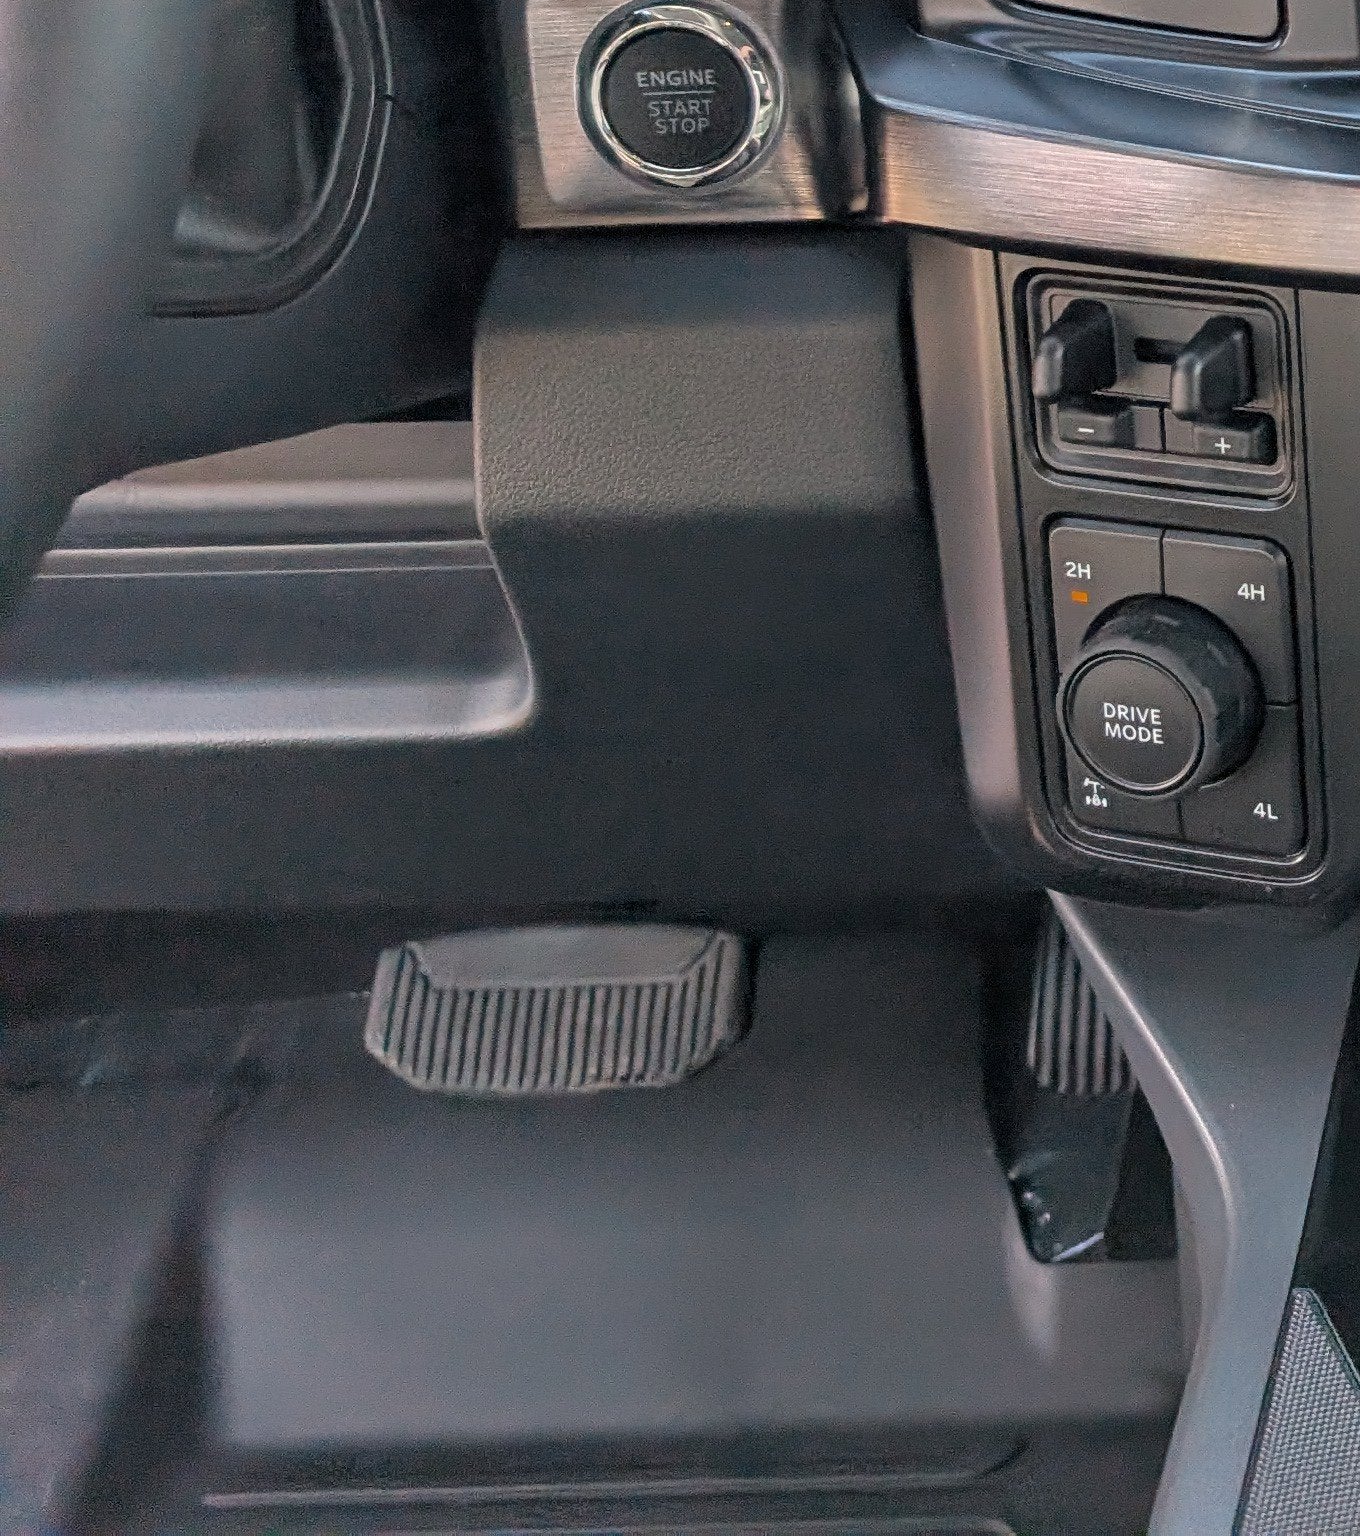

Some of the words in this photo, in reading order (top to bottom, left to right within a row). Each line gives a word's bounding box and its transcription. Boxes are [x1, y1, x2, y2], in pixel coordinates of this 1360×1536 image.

[637, 69, 717, 87] ENGINE
[649, 100, 711, 117] START
[655, 118, 710, 134] STOP
[1066, 562, 1090, 579] 2H
[1238, 583, 1265, 600] 4H
[1104, 703, 1161, 724] DRIVE
[1105, 721, 1163, 744] MODE
[1254, 803, 1278, 819] 4L
